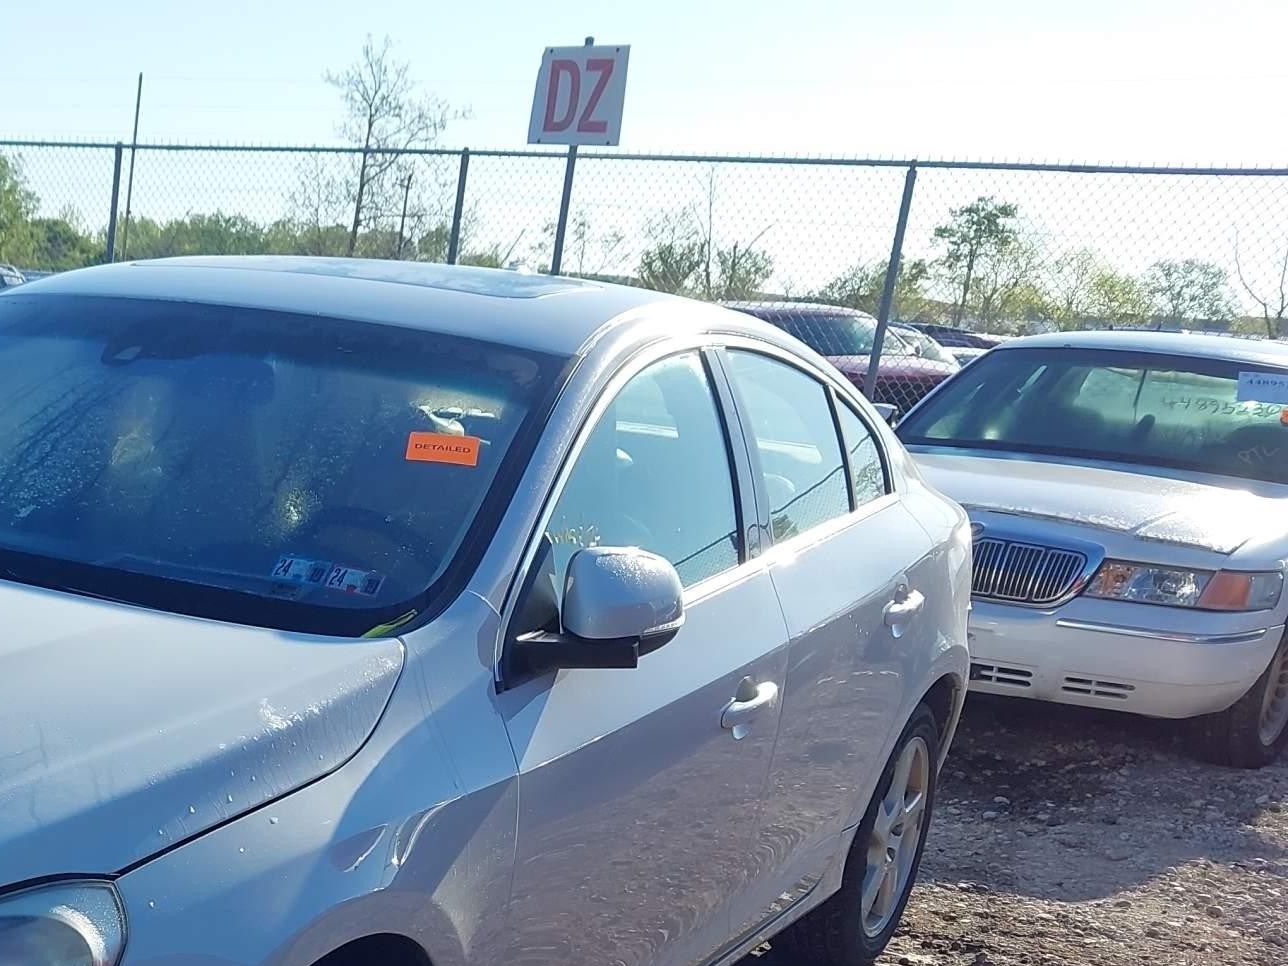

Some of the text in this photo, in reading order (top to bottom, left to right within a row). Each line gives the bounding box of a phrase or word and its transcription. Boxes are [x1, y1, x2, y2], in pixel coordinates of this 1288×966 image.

[542, 58, 615, 133] DZ
[414, 443, 471, 453] DETAILED
[274, 559, 294, 577] 24
[328, 567, 348, 587] 24
